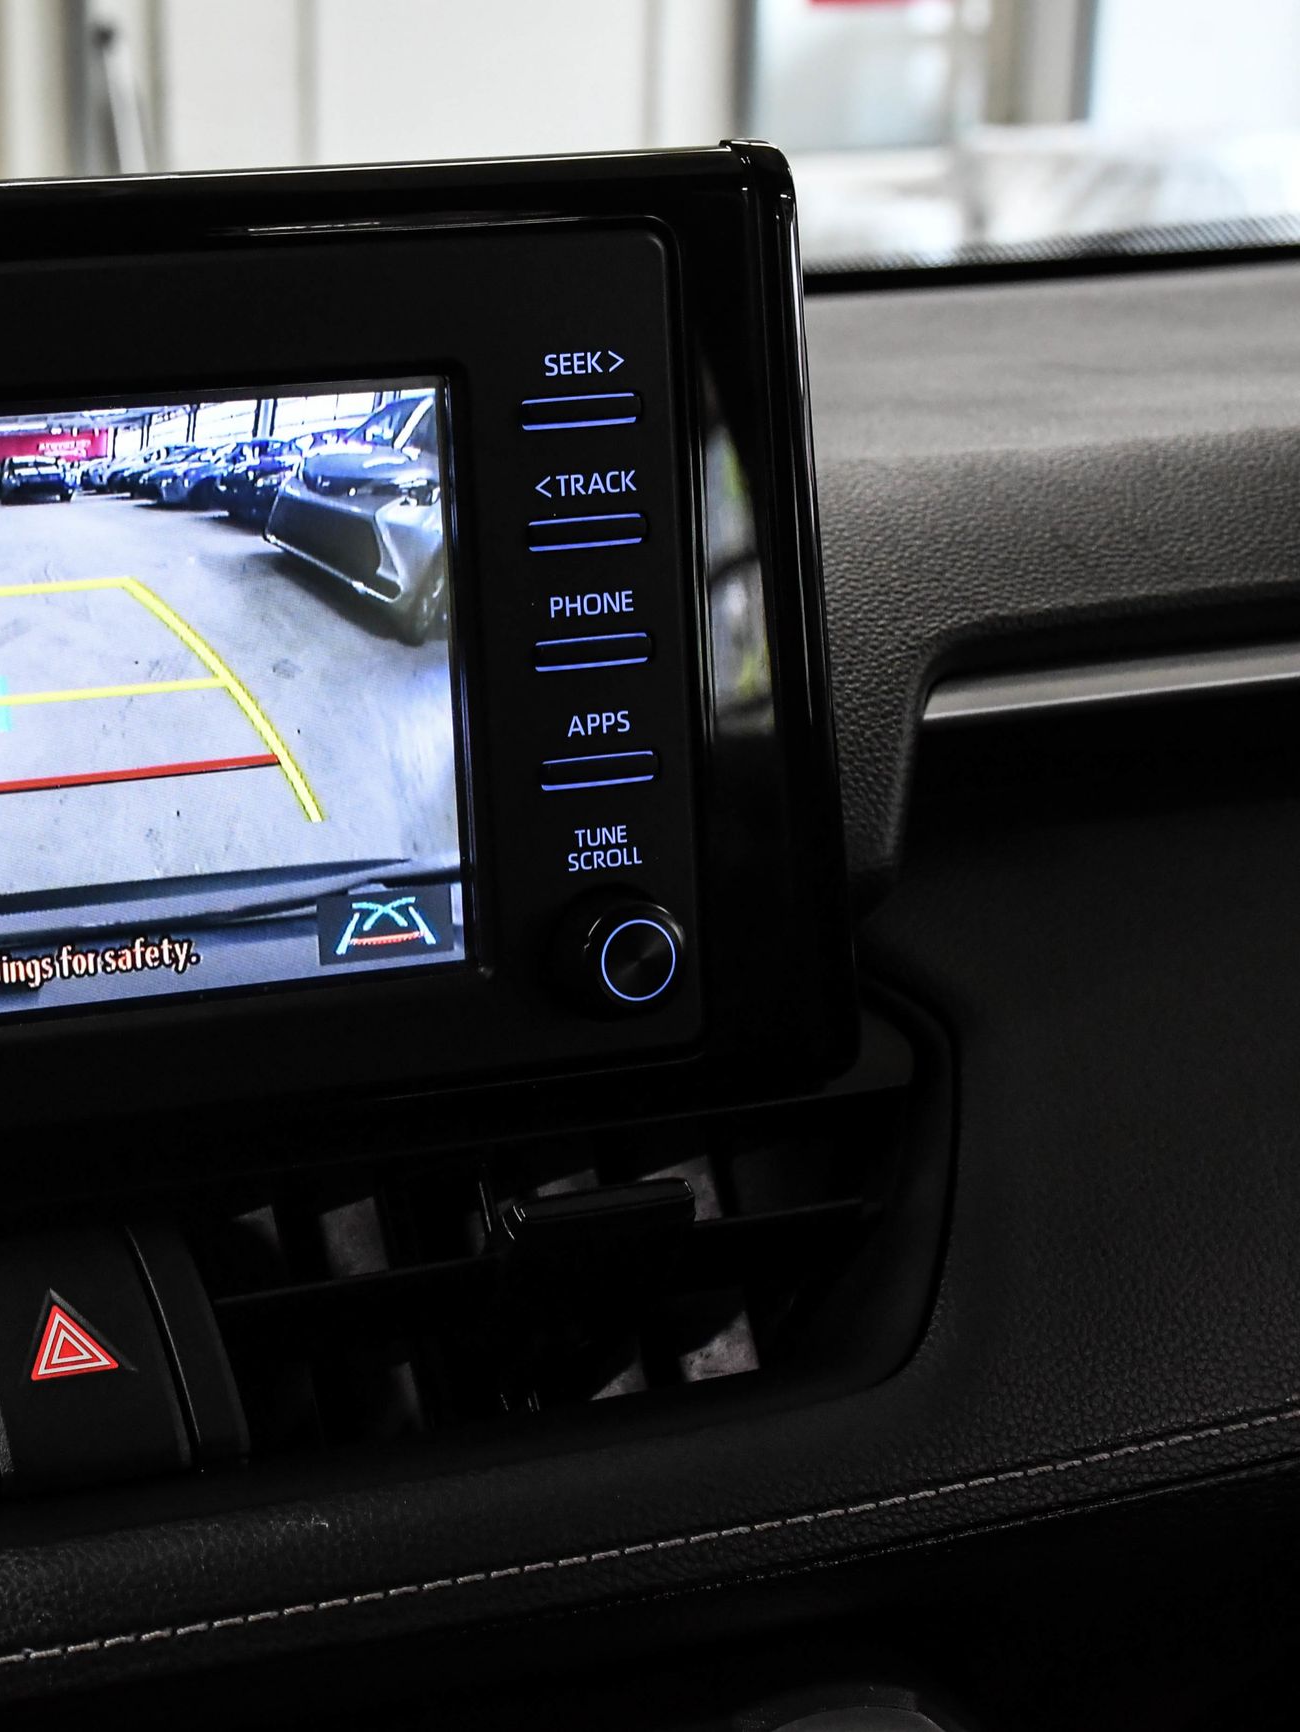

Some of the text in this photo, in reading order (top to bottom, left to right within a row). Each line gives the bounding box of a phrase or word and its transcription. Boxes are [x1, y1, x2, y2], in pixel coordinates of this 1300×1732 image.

[549, 590, 634, 619] PHONE
[567, 710, 631, 738] APPS
[574, 824, 628, 848] TUNE
[567, 846, 643, 872] SCROLL
[58, 945, 100, 977] for
[104, 936, 199, 971] safety.
